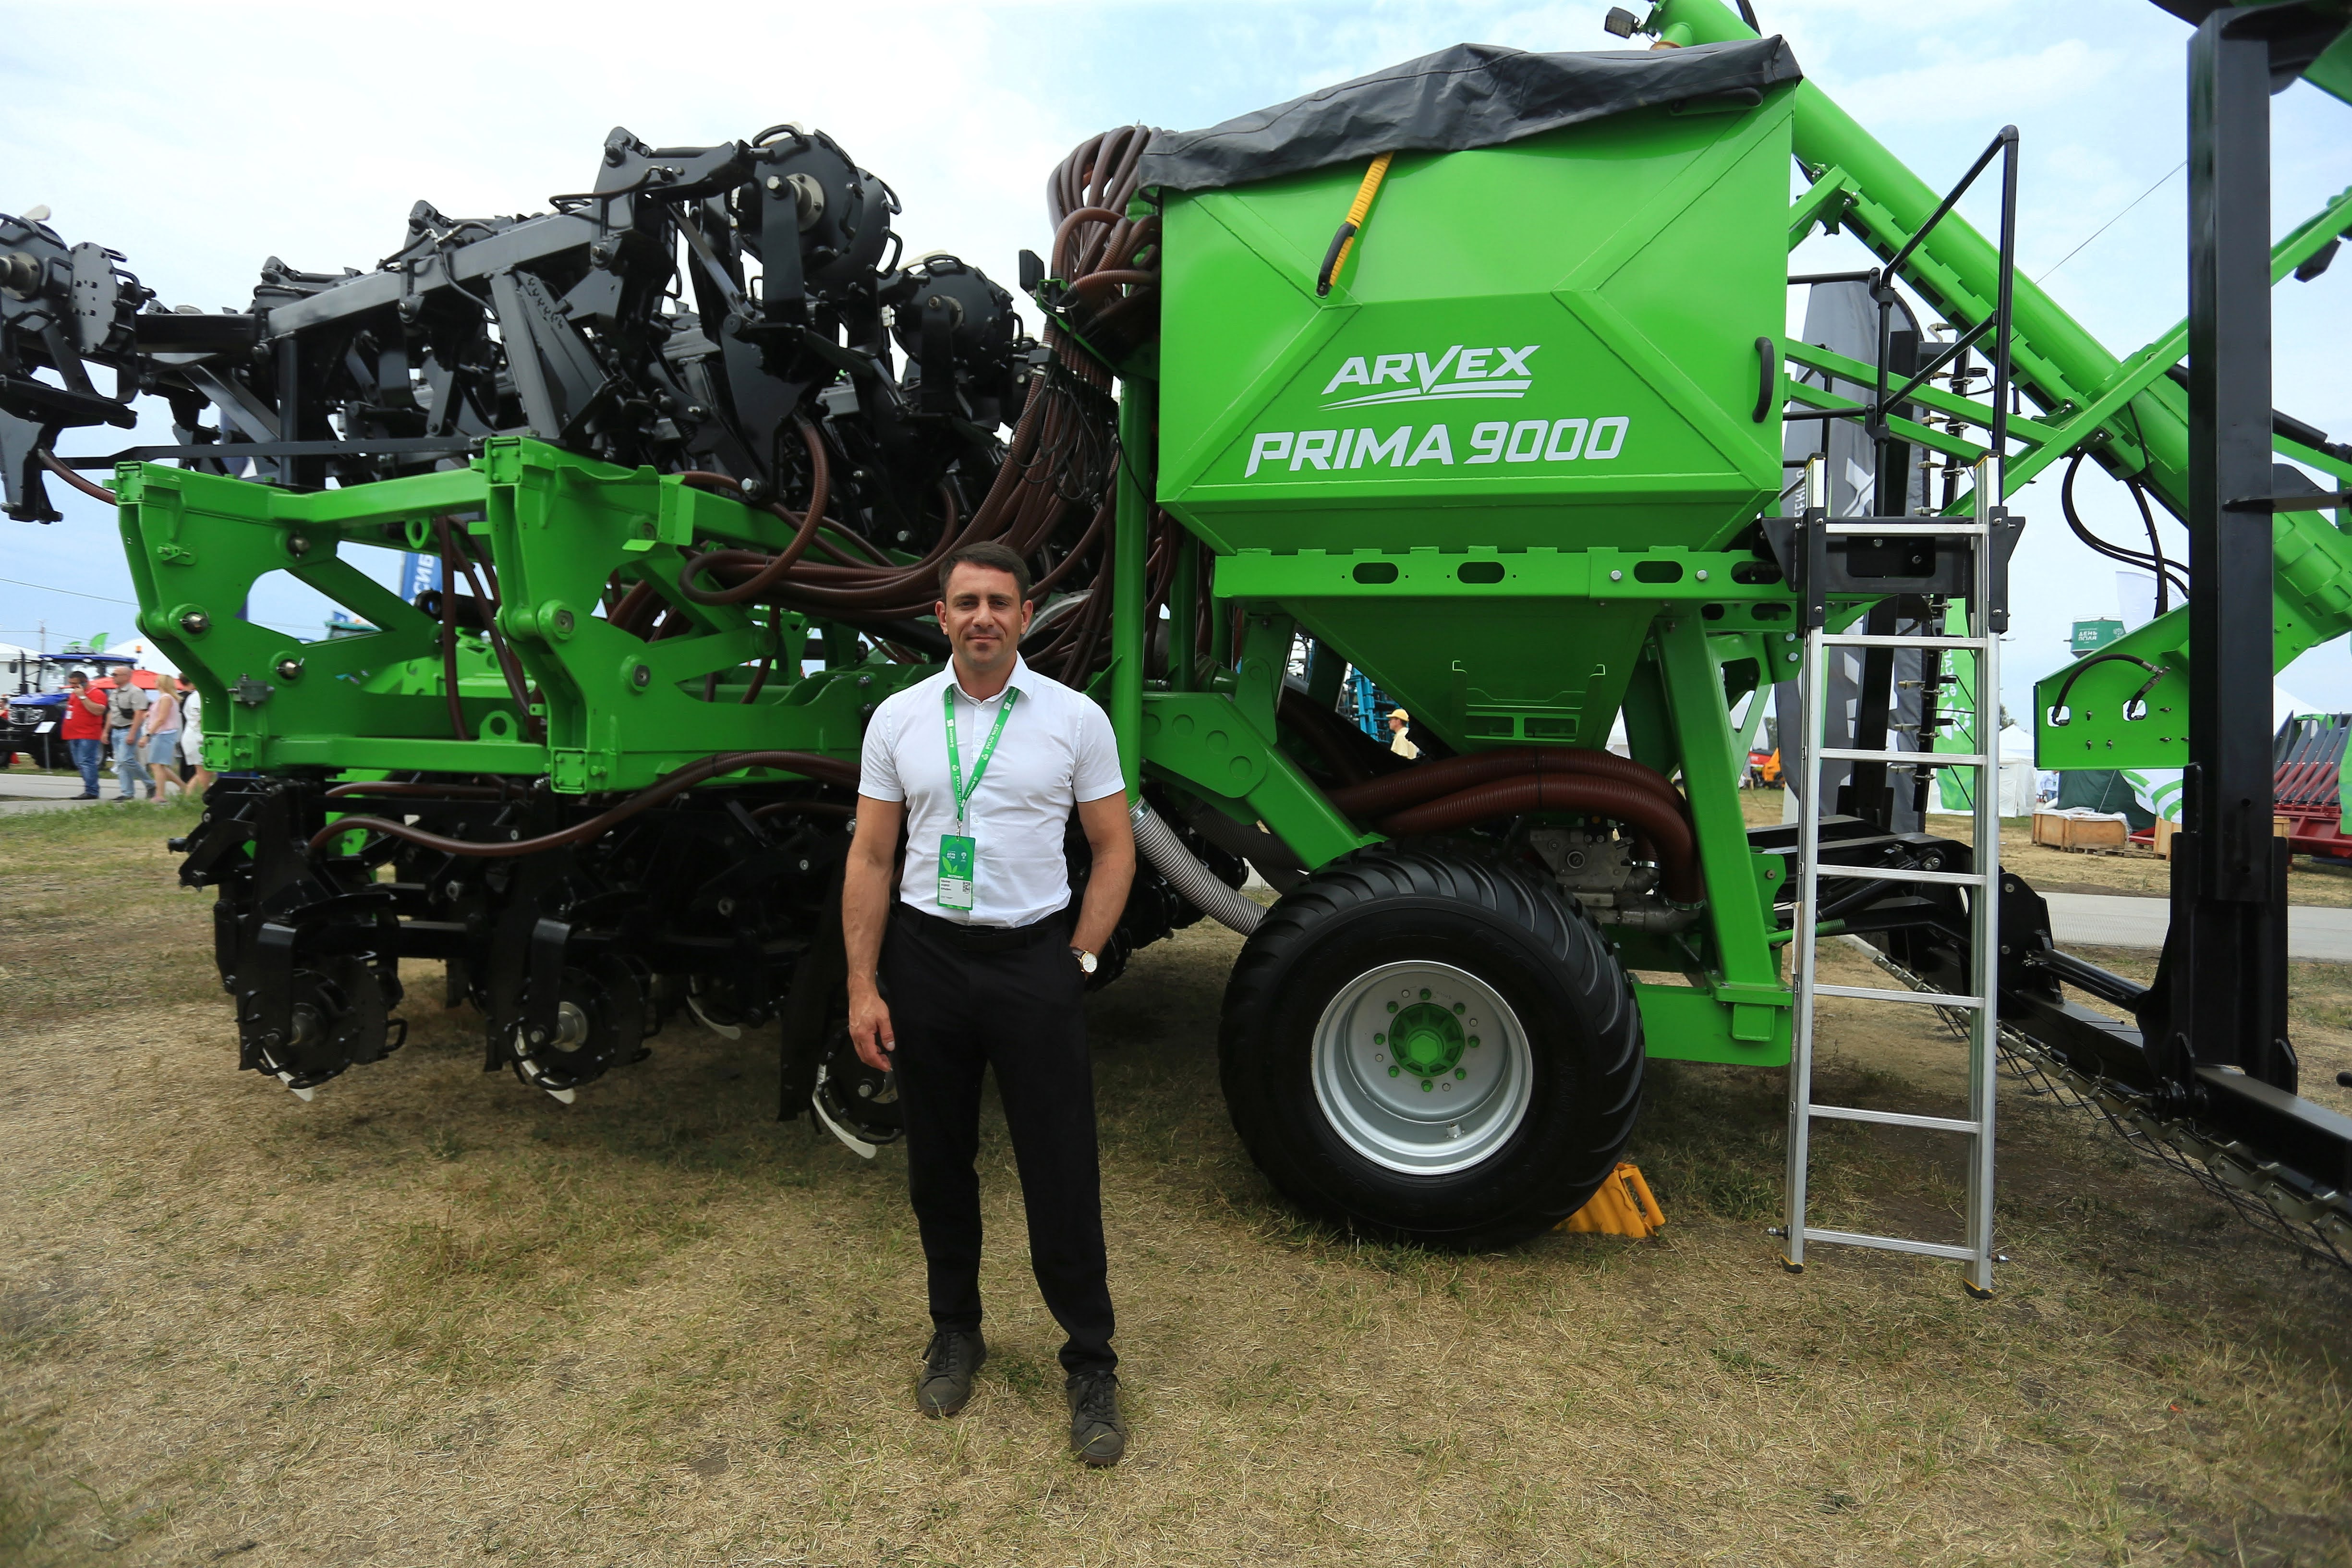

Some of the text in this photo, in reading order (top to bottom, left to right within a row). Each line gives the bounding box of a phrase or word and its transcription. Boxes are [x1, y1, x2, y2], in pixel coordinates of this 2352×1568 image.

[1321, 344, 1541, 395] ARVEX
[1244, 416, 1629, 478] PRIMA 9000
[408, 554, 434, 606] СИБ
[984, 735, 994, 750] ПОЛЯ
[991, 723, 999, 736] ДЕНЬ
